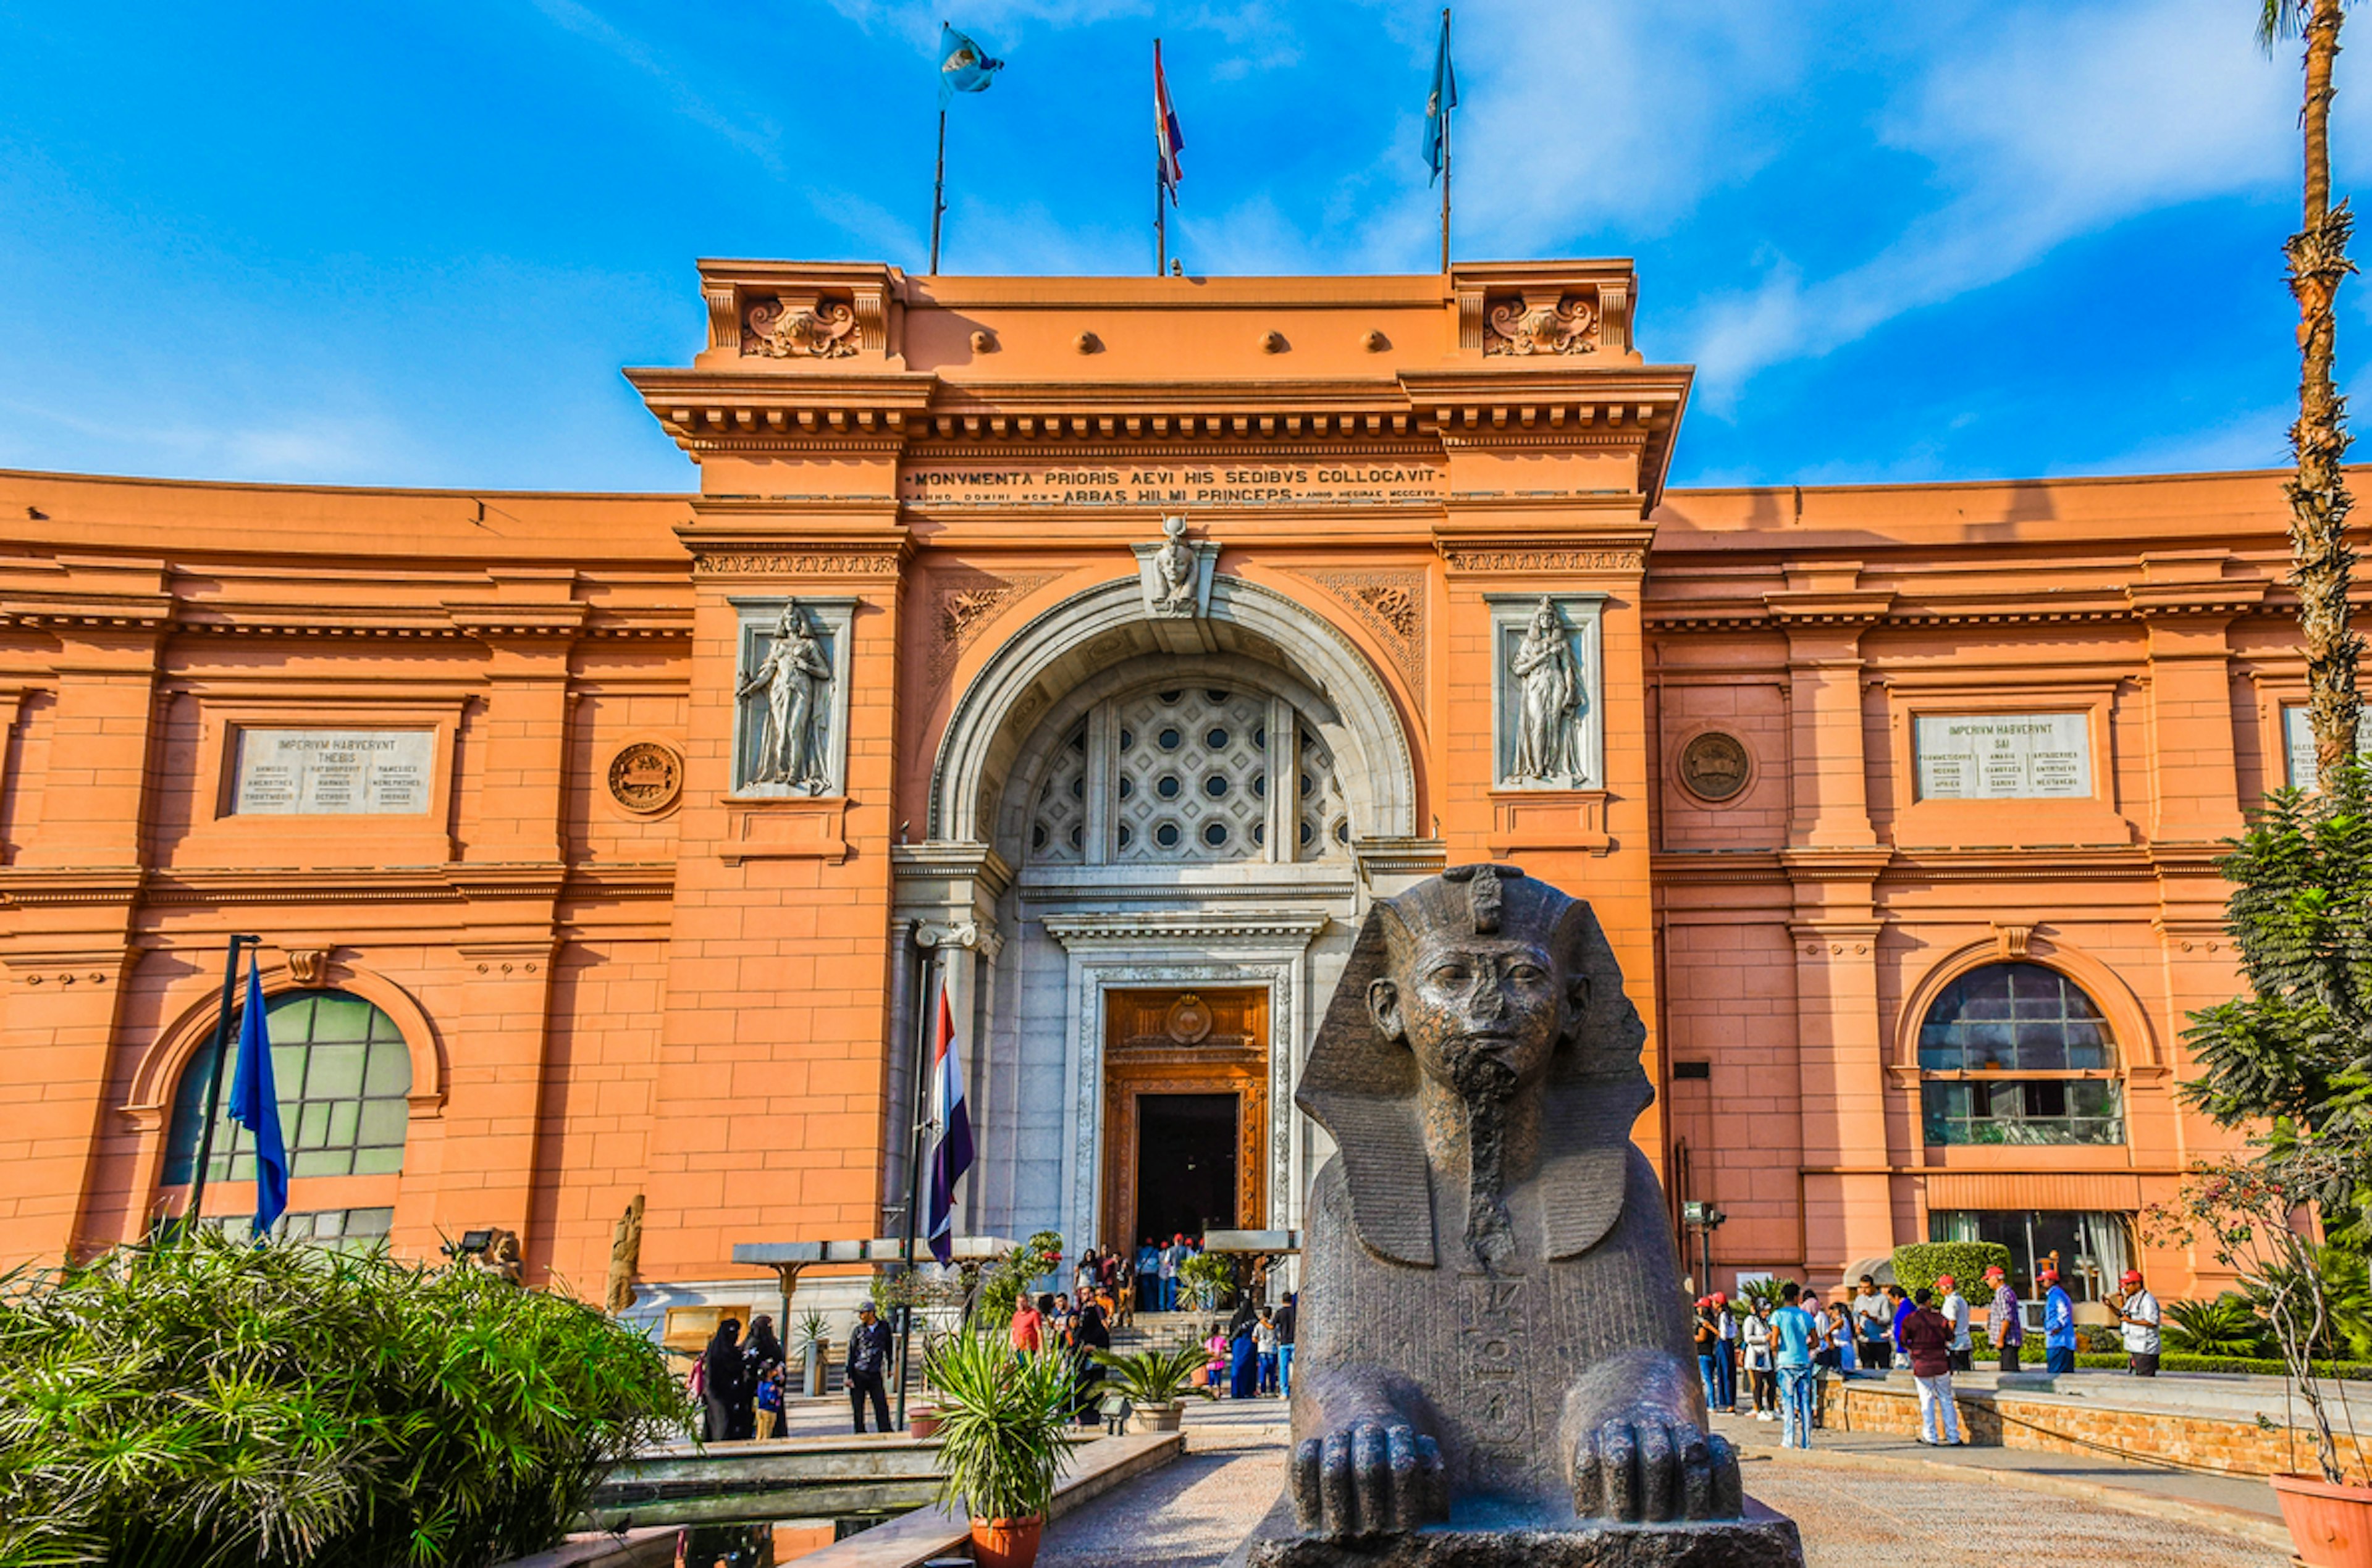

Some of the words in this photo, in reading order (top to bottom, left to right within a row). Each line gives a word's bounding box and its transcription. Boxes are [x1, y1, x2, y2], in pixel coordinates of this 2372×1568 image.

[915, 472, 1033, 485] MONVMENTA
[1045, 472, 1119, 485] PRIORIS
[1130, 471, 1174, 485] AEVI
[1185, 471, 1215, 484] HIS
[1226, 471, 1308, 484] SEDIBVS
[1318, 469, 1436, 484] COLLOCAVIT
[1064, 490, 1128, 502] ABBAS
[1137, 489, 1187, 501] HILMI
[1197, 488, 1292, 501] PRINCEPS
[1996, 723, 2053, 735] HABVERVNT
[1994, 739, 2010, 749] SAI
[318, 752, 356, 764] THEBIS
